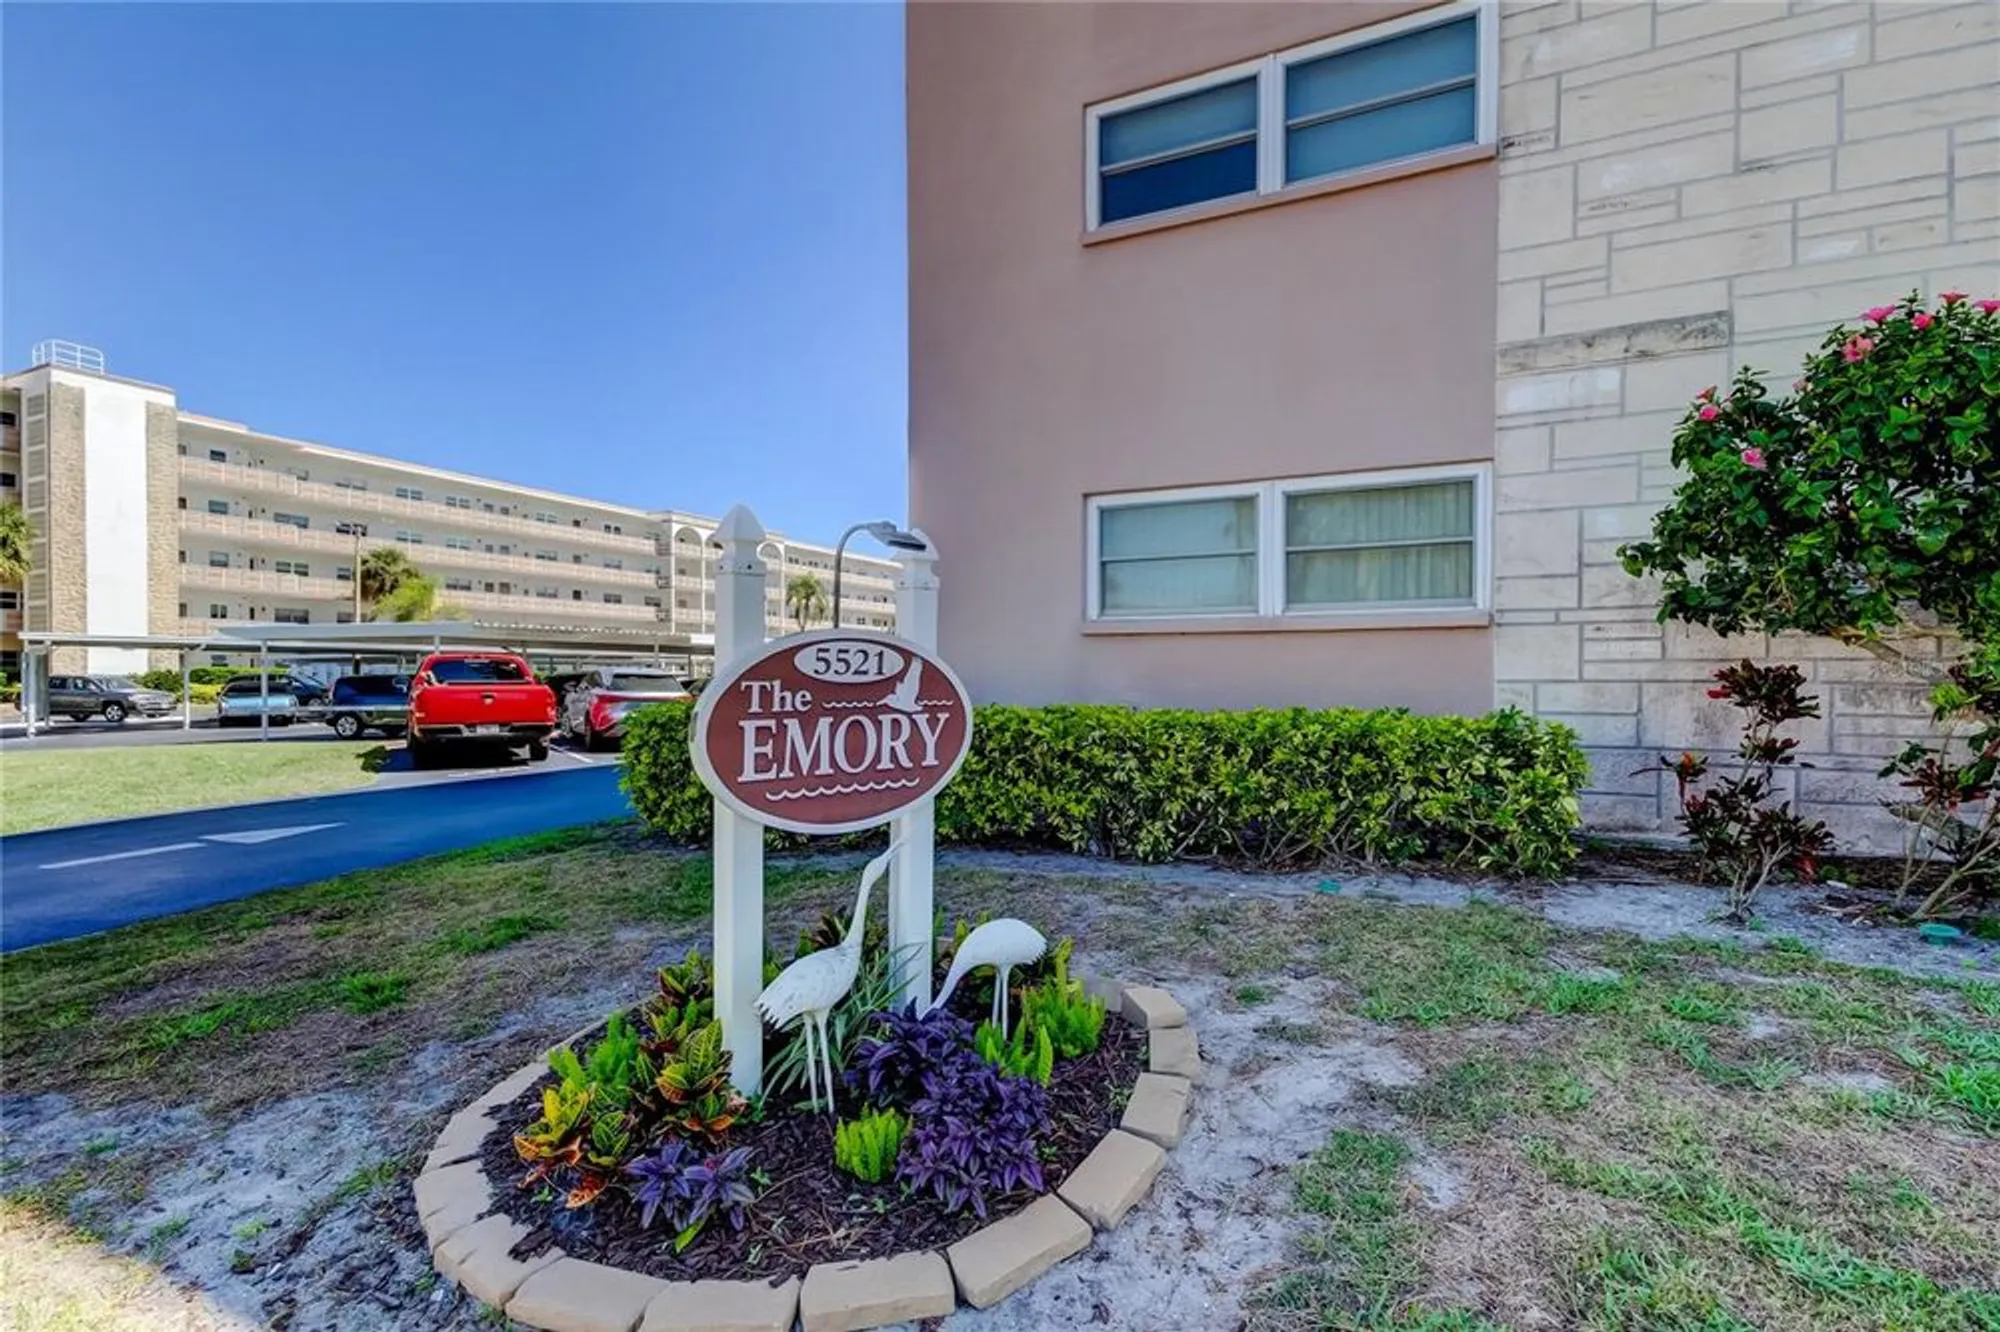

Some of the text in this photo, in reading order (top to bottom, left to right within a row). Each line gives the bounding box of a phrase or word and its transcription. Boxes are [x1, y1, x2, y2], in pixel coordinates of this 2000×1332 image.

[813, 648, 886, 676] 5521
[741, 680, 813, 713] The
[738, 712, 950, 783] EMORY
